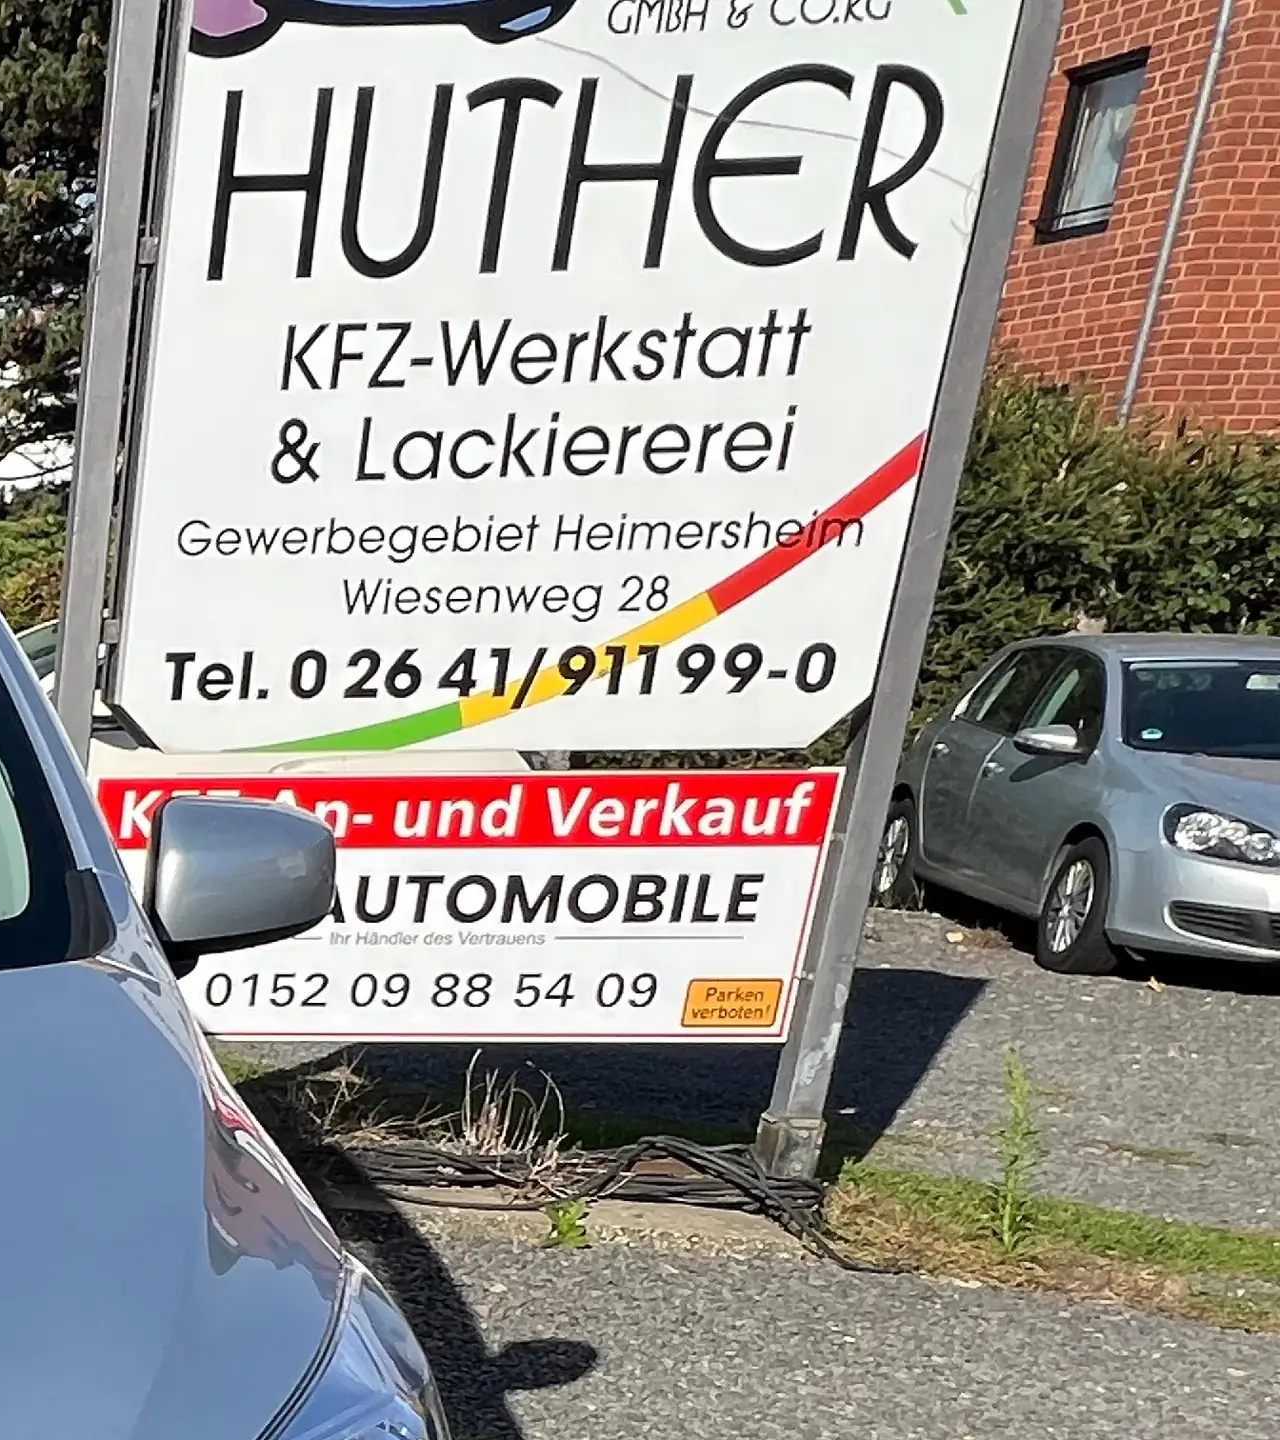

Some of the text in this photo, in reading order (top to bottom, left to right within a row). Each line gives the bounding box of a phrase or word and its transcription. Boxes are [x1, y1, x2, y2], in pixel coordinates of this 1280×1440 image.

[727, 0, 753, 28] &
[206, 62, 944, 281] HUTHER
[280, 308, 812, 391] KFZ-Werkstatt
[272, 404, 798, 484] & Lackiererei
[177, 510, 864, 564] Gewerbegebiet Heimersheim
[343, 575, 670, 623] Wiesenweg 28
[166, 651, 269, 701] Tel.
[393, 785, 519, 836] und
[548, 781, 814, 837] Verkauf
[355, 931, 419, 946] Händler
[423, 931, 453, 946] des
[458, 931, 546, 946] Vertrauens
[206, 972, 657, 1008] 0152 09 88 54 09
[692, 1004, 771, 1019] verboten!
[705, 987, 764, 1002] Parken
